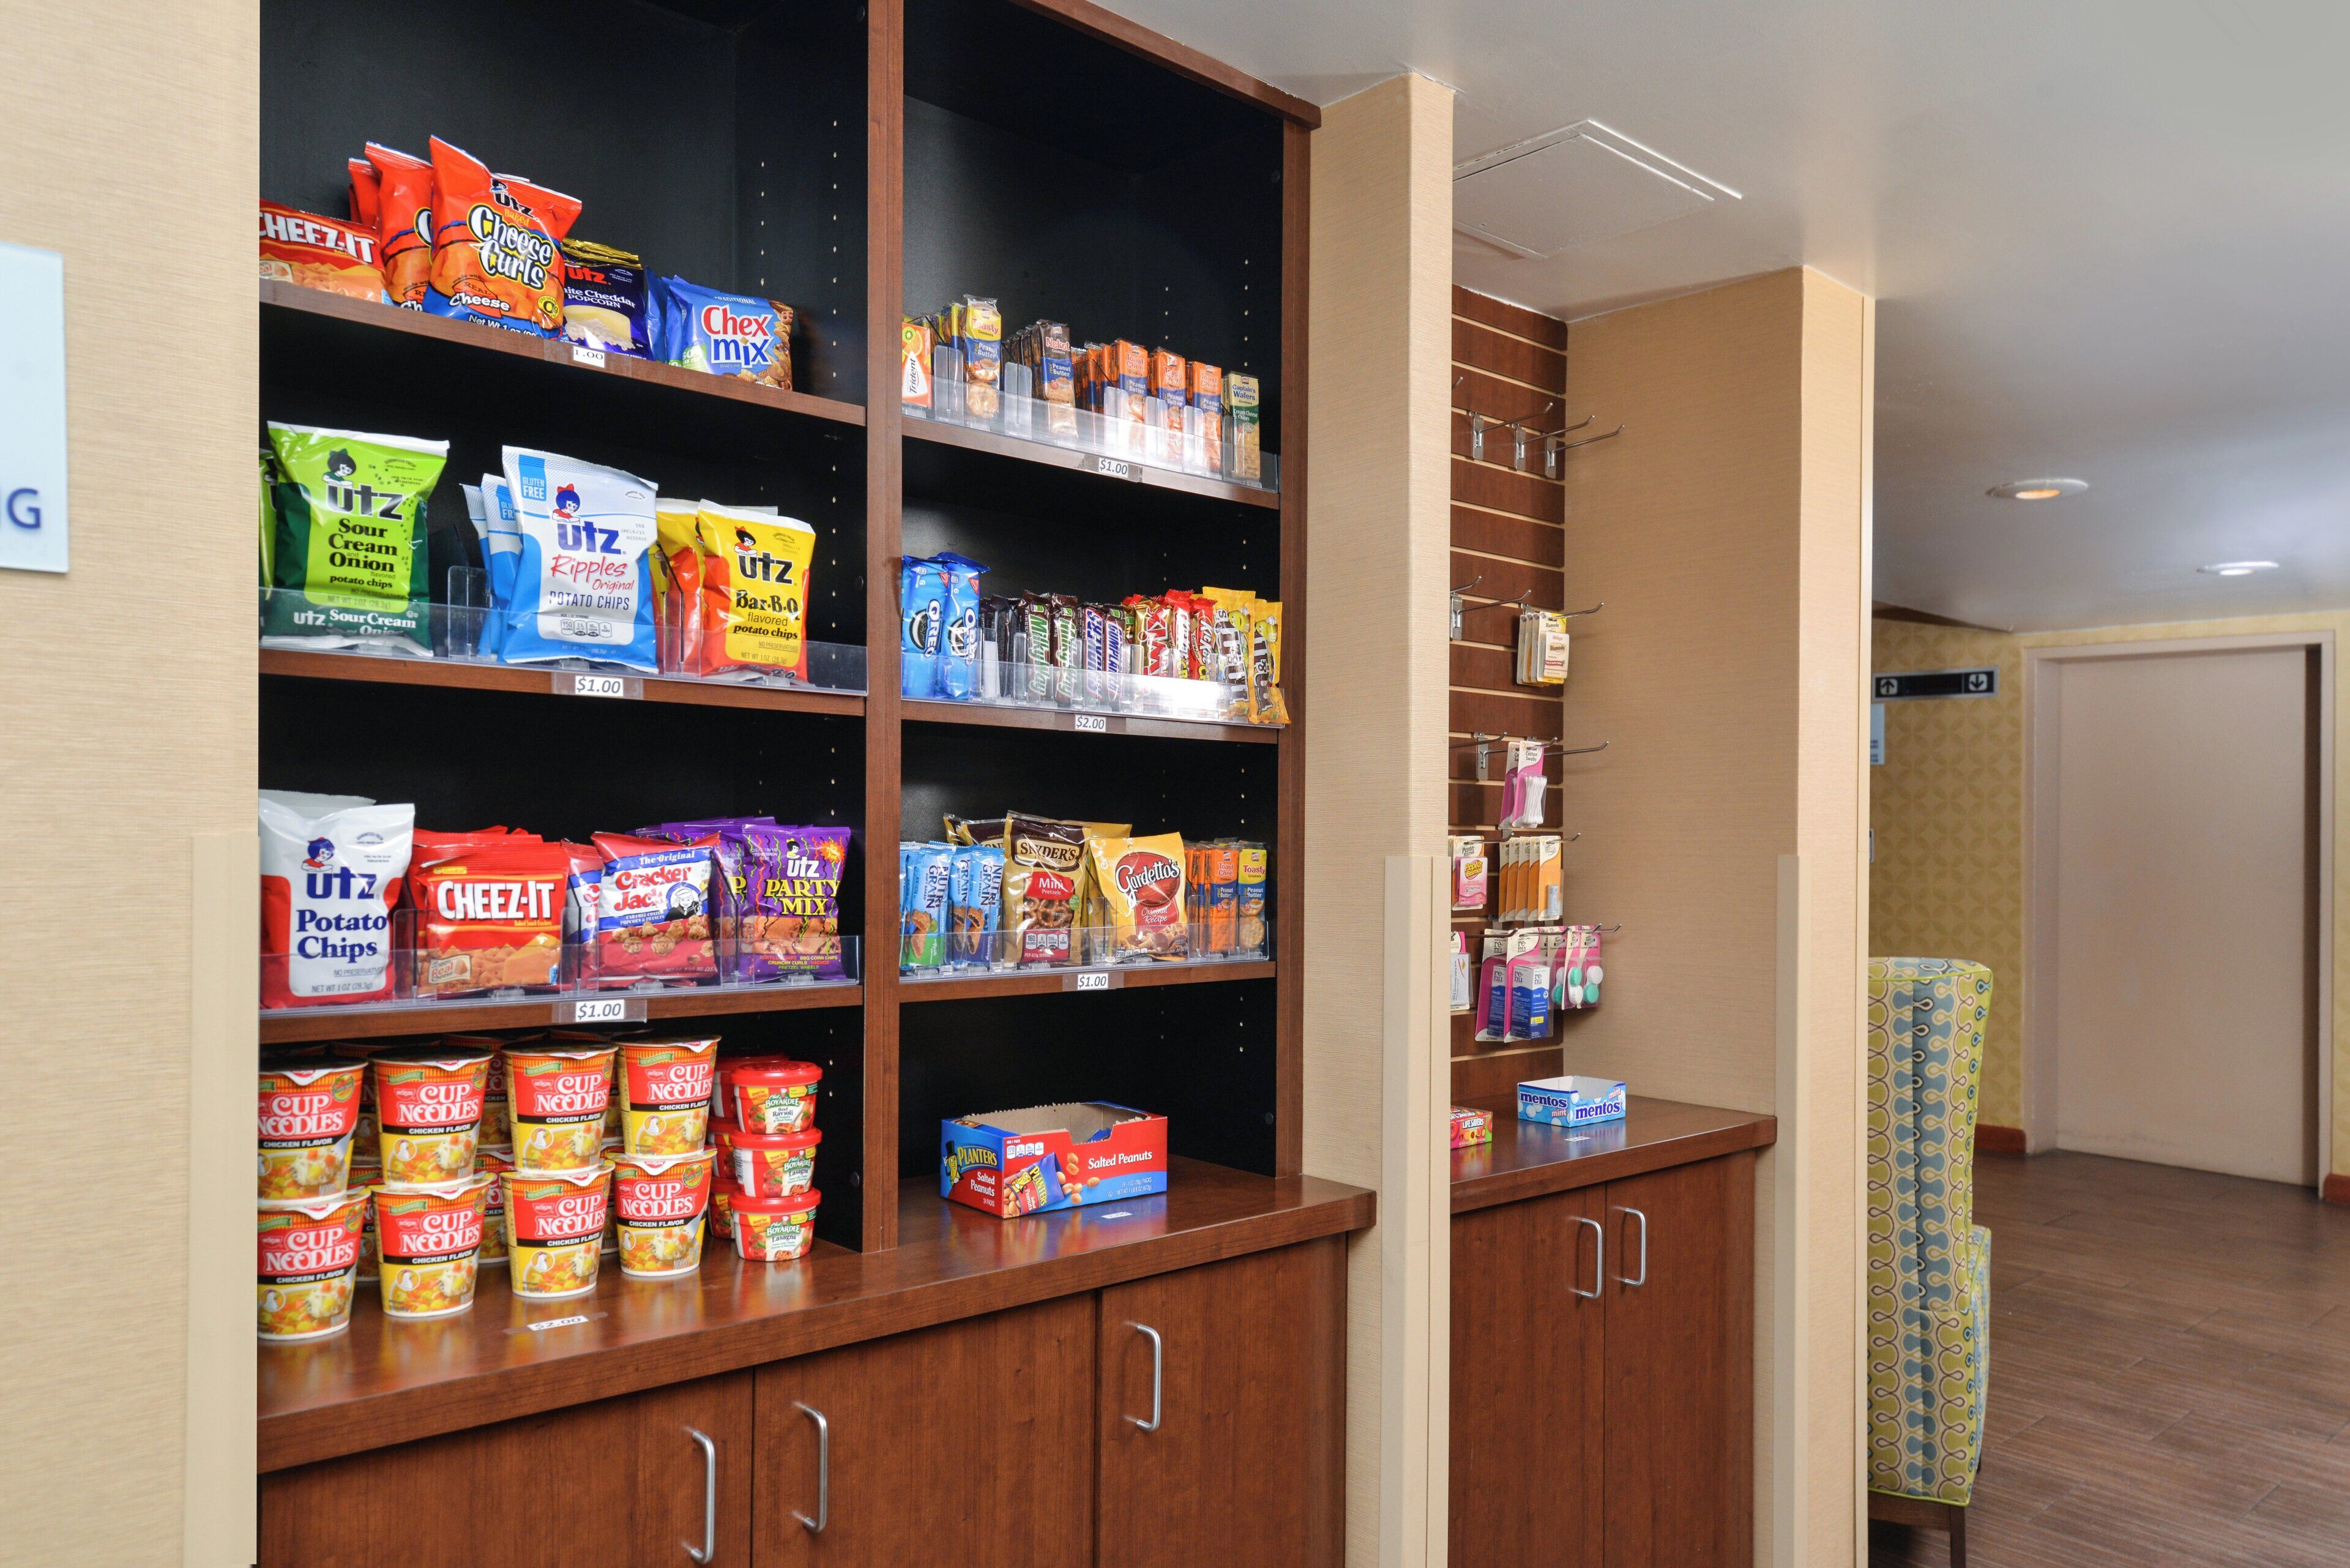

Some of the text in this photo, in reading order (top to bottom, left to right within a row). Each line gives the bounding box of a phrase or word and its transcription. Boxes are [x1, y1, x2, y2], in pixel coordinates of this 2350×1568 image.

[504, 209, 530, 226] Baked
[471, 206, 551, 265] Cheese
[480, 240, 543, 288] Curls
[464, 282, 491, 295] REAL
[450, 292, 510, 312] Cheese
[568, 294, 621, 308] POPCORN
[584, 290, 636, 308] Cheddar
[703, 307, 769, 337] Chex
[714, 338, 770, 365] mix
[979, 342, 998, 354] Peanut
[1045, 337, 1070, 351] Nekot
[978, 349, 996, 359] Butter
[1126, 353, 1144, 365] Toast
[1053, 363, 1071, 371] Peanut
[1126, 361, 1144, 371] Chee
[1129, 380, 1146, 389] Peanut
[1201, 373, 1218, 384] Toast
[1201, 380, 1218, 390] Chee
[1129, 386, 1144, 394] Butter
[1167, 392, 1184, 402] Peanut
[1233, 384, 1256, 394] Captain's
[1233, 390, 1256, 401] Wafers
[1167, 398, 1183, 407] Butter
[1234, 408, 1245, 416] Cream
[1100, 459, 1128, 476] $1.00
[522, 477, 545, 487] GLUTEN
[523, 487, 545, 499] FREE
[338, 518, 387, 538] Sour
[329, 534, 398, 556] Cream
[329, 552, 395, 572] Onion
[551, 554, 628, 583] Ripples
[330, 576, 393, 589] potato chips
[592, 579, 635, 594] Original
[550, 591, 630, 610] POTATO CHIPS
[329, 609, 367, 623] Sour
[367, 613, 416, 629] Cream
[748, 612, 788, 627] flavored
[734, 625, 798, 640] potato chips
[927, 599, 941, 657] OREO
[576, 678, 621, 694] $1.00
[1076, 715, 1105, 730] $2.00
[658, 851, 695, 863] Original
[1021, 842, 1076, 861] SNYDER'S
[1243, 865, 1266, 875] Toasty
[1464, 861, 1483, 870] Pepto-
[1466, 867, 1482, 878] Bismol
[615, 866, 692, 891] Cracker
[926, 865, 938, 909] GRAIN
[980, 864, 992, 906] GRAIN
[988, 865, 1002, 906] NUTRI
[1039, 878, 1064, 889] Mini
[1116, 858, 1181, 908] Gardetto's
[764, 879, 840, 897] PARTY
[437, 880, 554, 919] CHEEZ-IT
[780, 898, 828, 916] MIX
[296, 909, 386, 932] Potato
[1142, 906, 1168, 918] Original
[1145, 916, 1168, 925] Recipe
[297, 936, 378, 963] Chips
[432, 965, 453, 977] Real
[1078, 975, 1107, 988] $1.00
[578, 1003, 622, 1020] $1.00
[670, 1064, 707, 1082] CUP
[558, 1074, 602, 1094] CUP
[649, 1080, 712, 1101] NOODLES
[420, 1083, 471, 1104] CUP
[536, 1089, 607, 1112] NOODLES
[1520, 1092, 1567, 1108] mentos
[1609, 1088, 1621, 1100] mint
[272, 1094, 330, 1116] CUP
[399, 1100, 479, 1123] NOODLES
[766, 1098, 799, 1108] BOYARDEE
[1575, 1101, 1621, 1119] mentos
[580, 1113, 600, 1121] FLAVOR
[446, 1124, 471, 1133] FLAVOR
[302, 1138, 333, 1147] FLAVOR
[958, 1146, 998, 1166] PLANTERS
[1088, 1151, 1152, 1170] Salted Peanuts
[785, 1159, 811, 1171] BOYARDEE
[977, 1171, 995, 1185] Salted
[1029, 1165, 1047, 1206] PLANTERS
[635, 1182, 682, 1200] CUP
[971, 1180, 995, 1197] Peanuts
[558, 1195, 600, 1217] CUP
[621, 1196, 693, 1217] NOODLES
[423, 1210, 472, 1232] CUP
[537, 1212, 605, 1236] NOODLES
[580, 1233, 600, 1244] FLAVOR
[767, 1225, 801, 1236] BOYARDEE
[286, 1229, 341, 1250] CUP
[402, 1226, 480, 1253] NOODLES
[266, 1247, 354, 1272] NOODLES
[412, 1249, 472, 1264] CHICKEN FLAVOR
[277, 1269, 344, 1283] CHICKEN FLAVOR
